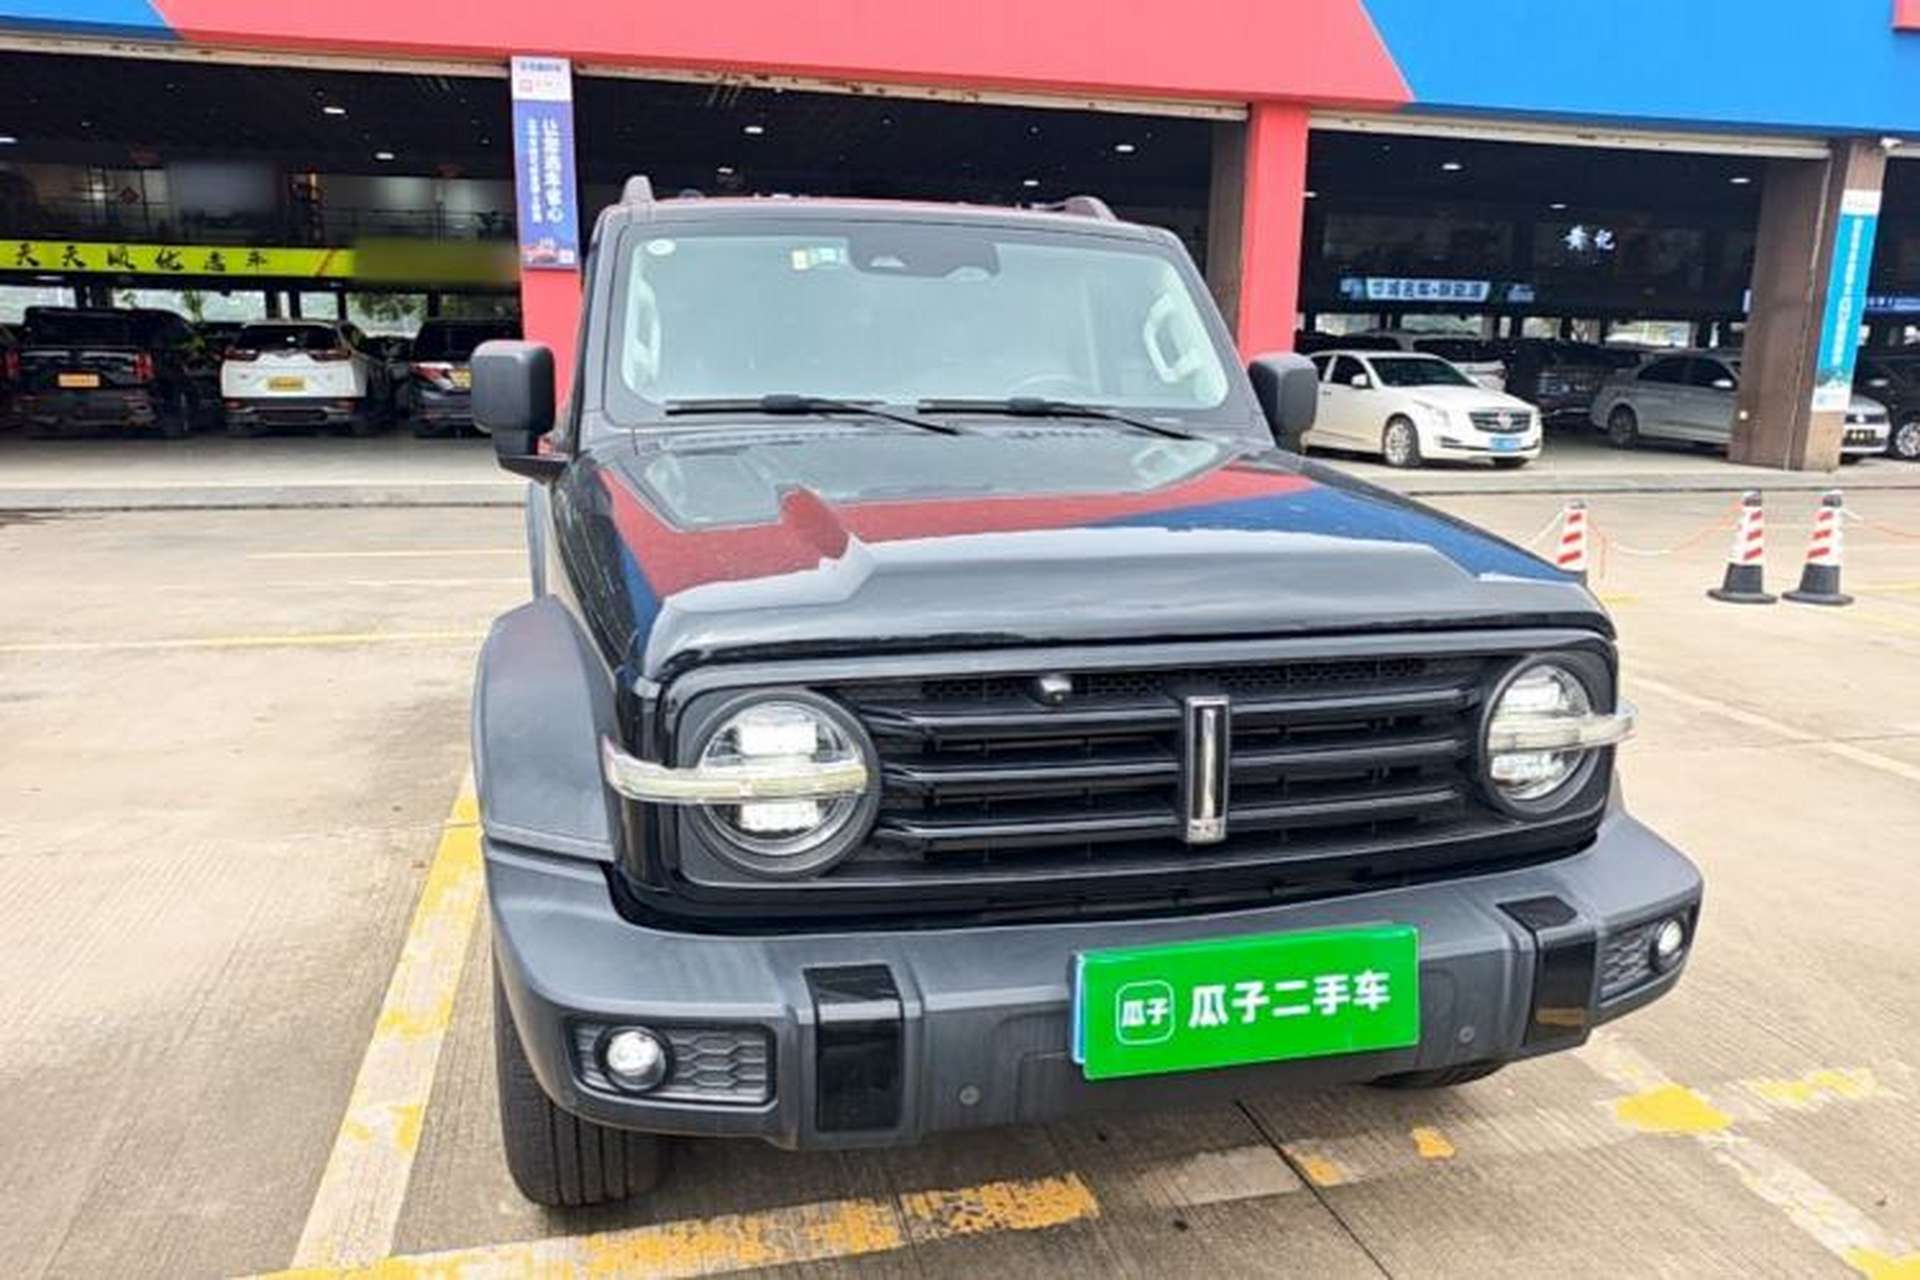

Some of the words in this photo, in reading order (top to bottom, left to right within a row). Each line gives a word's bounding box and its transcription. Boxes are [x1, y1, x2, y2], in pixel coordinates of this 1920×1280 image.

[1121, 998, 1168, 1028] 瓜子
[1188, 970, 1391, 1028] 瓜子二手车
